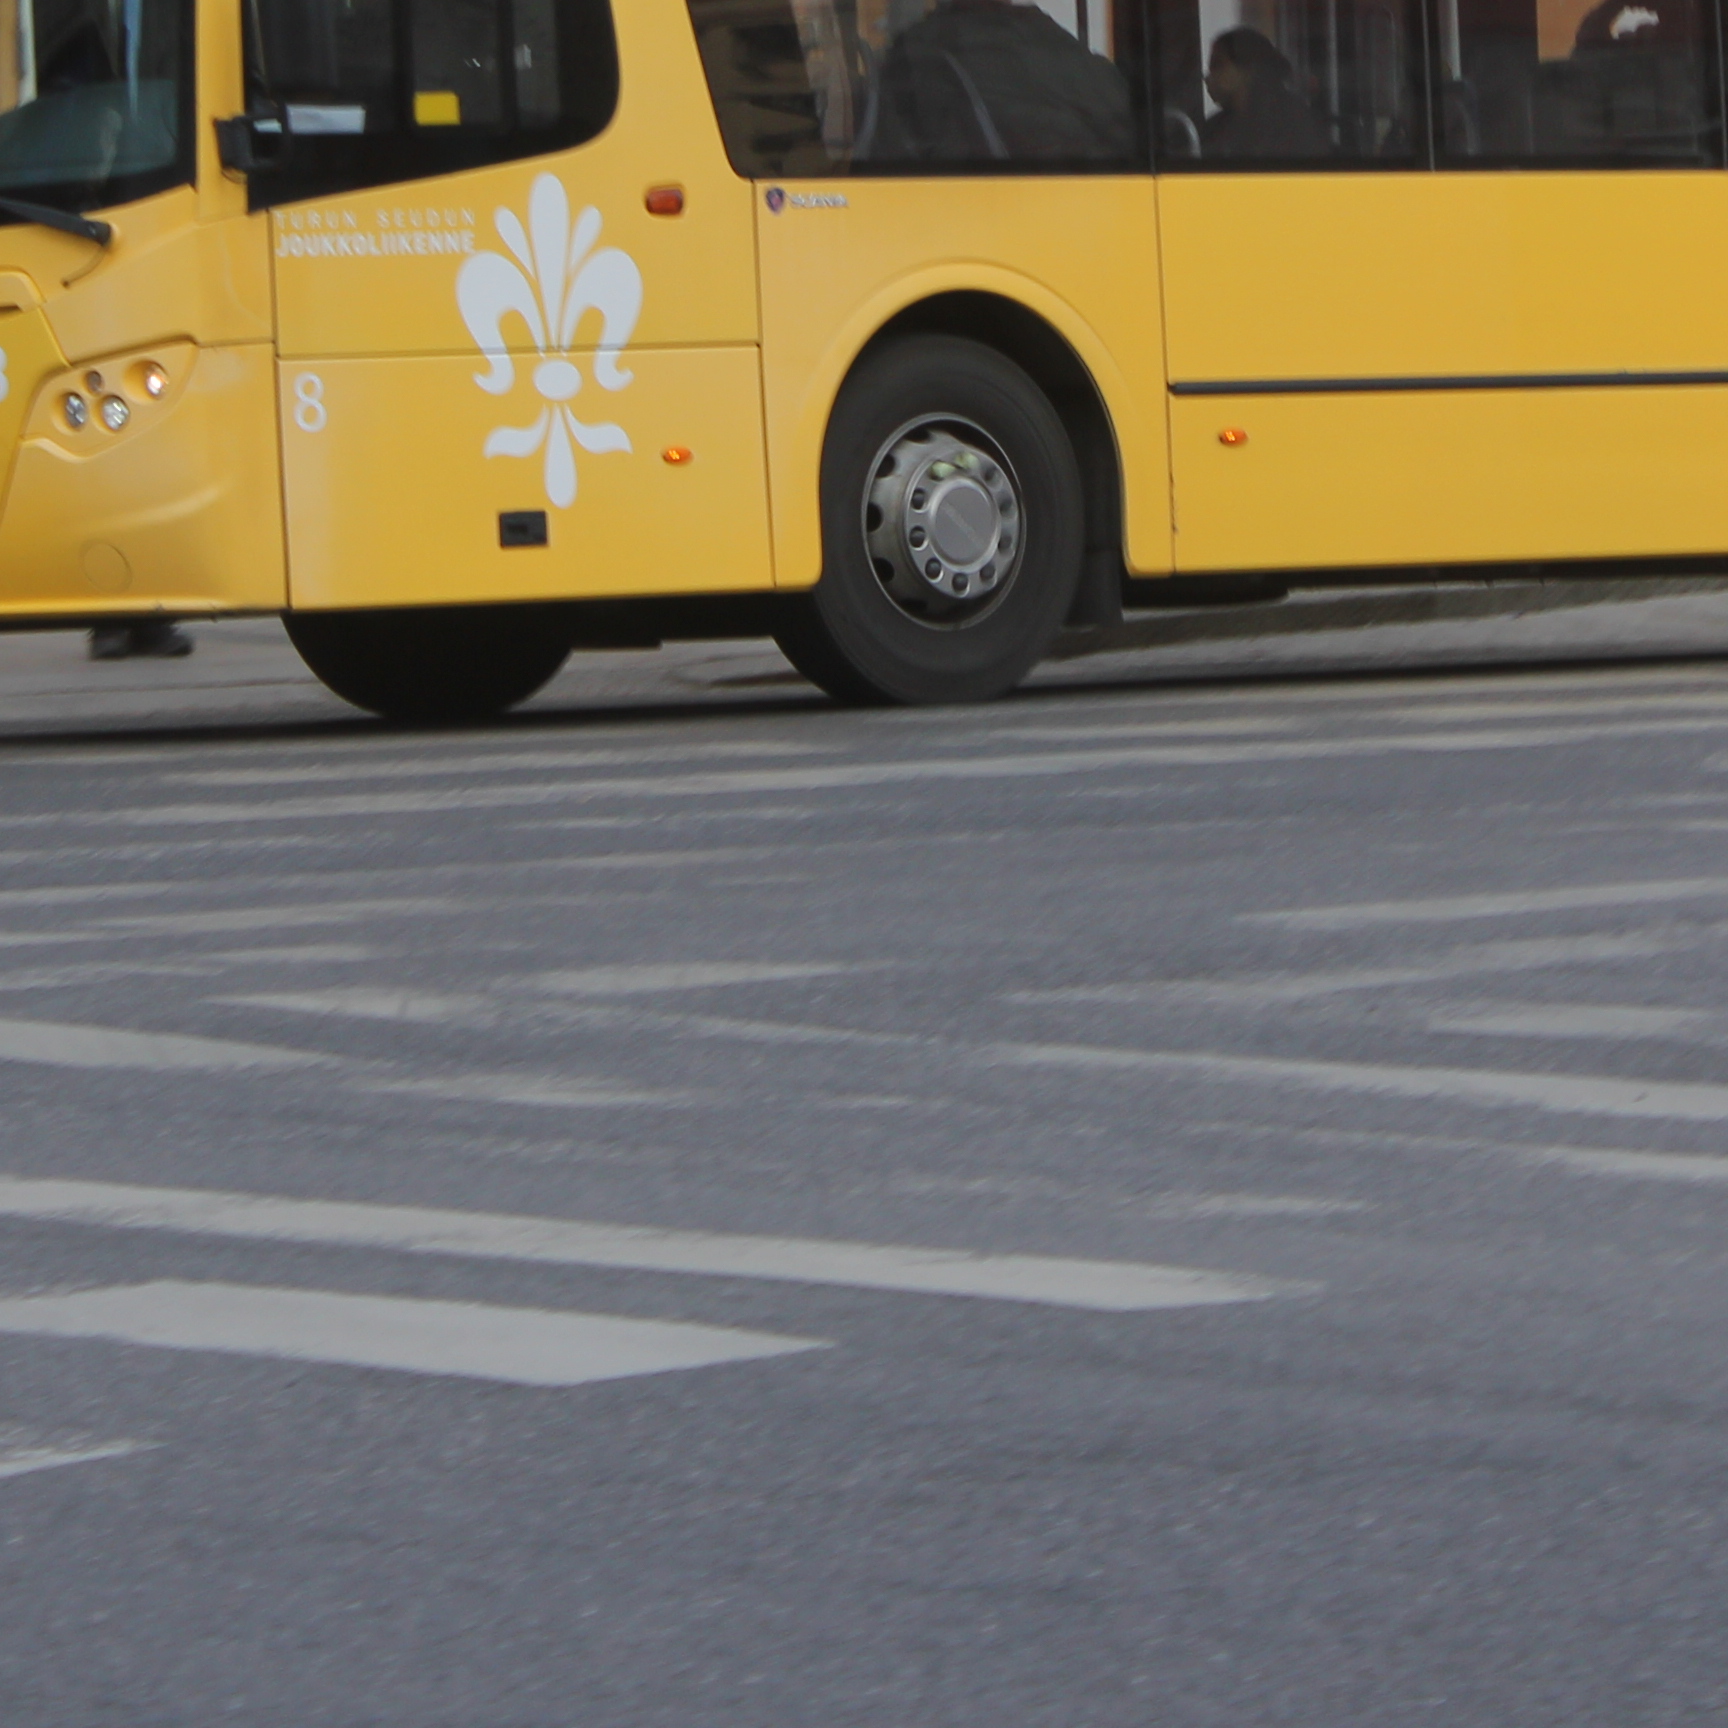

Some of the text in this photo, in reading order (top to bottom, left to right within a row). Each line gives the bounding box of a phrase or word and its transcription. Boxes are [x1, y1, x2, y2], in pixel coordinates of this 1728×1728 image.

[275, 207, 476, 229] TURUN SEUDUN
[275, 230, 476, 258] JOUKKOLIIKENNE
[292, 371, 328, 433] 8
